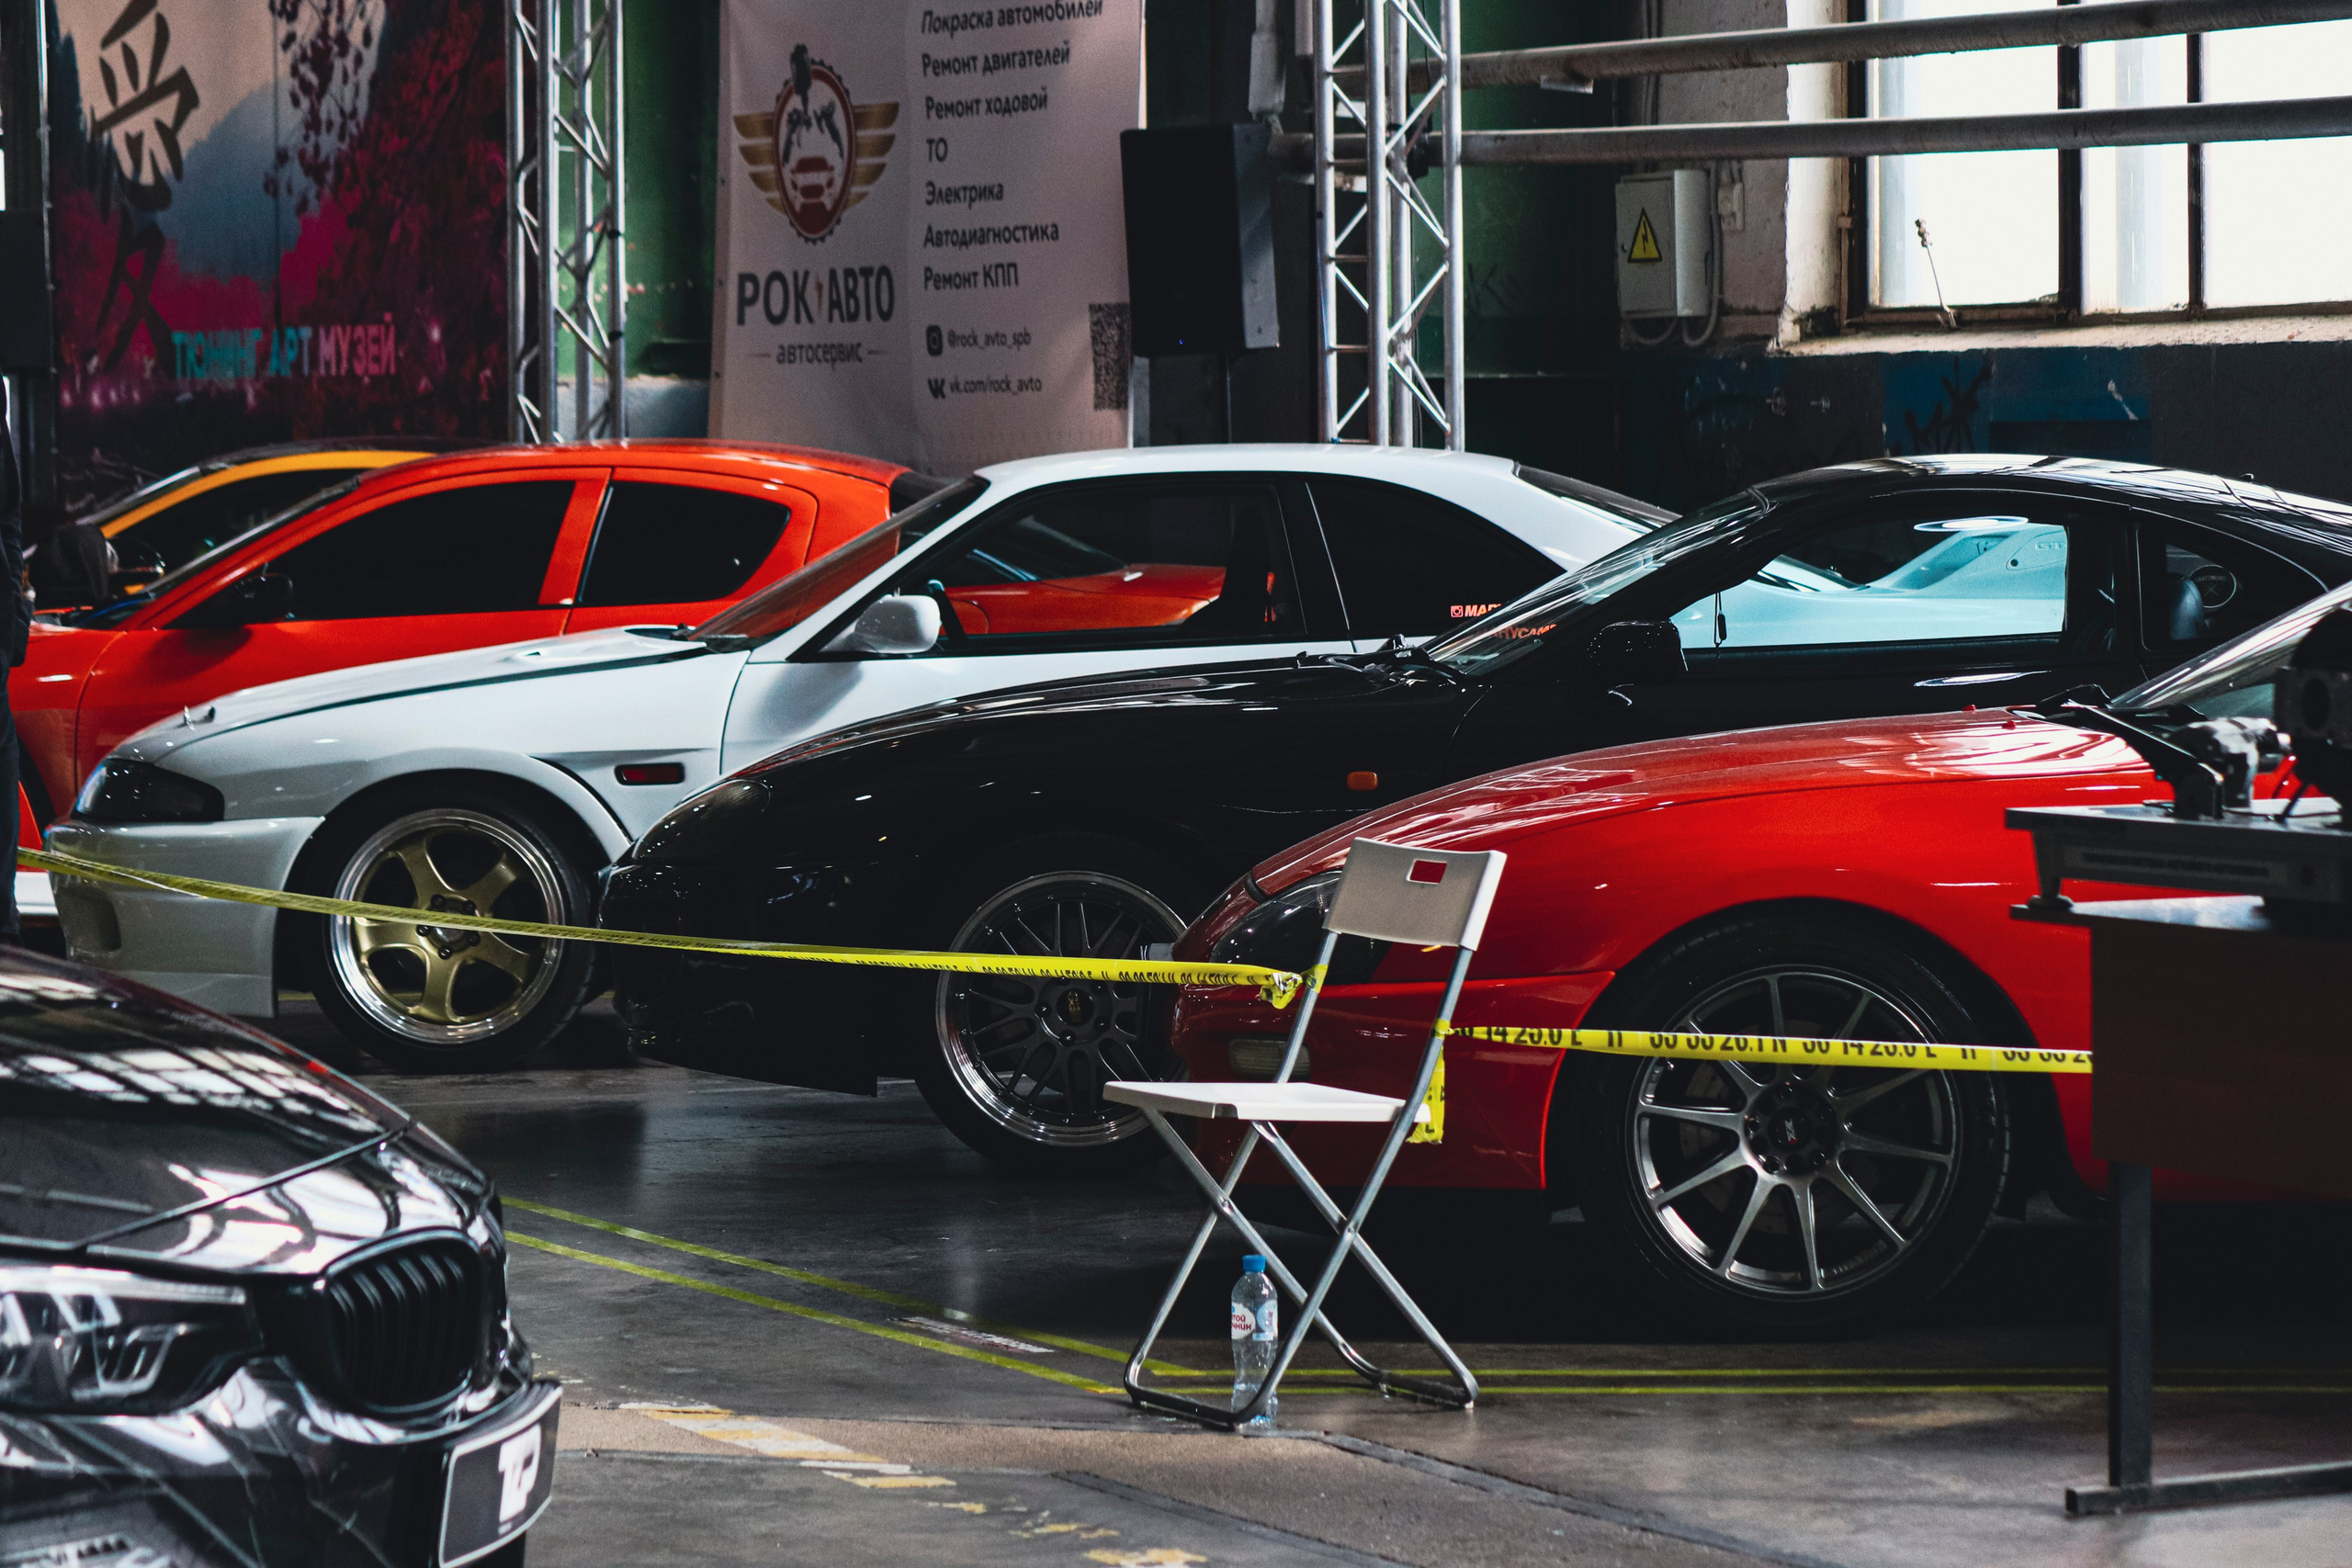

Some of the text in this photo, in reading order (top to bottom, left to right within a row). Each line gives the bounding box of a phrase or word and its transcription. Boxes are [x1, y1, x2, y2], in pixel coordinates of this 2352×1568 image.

[921, 0, 1103, 39] Покраска автомобилей
[922, 39, 1070, 77] Ремонт двигателей
[925, 86, 1048, 119] Ремонт ходовой
[925, 137, 949, 163] ТО
[925, 181, 1004, 210] Электрика
[922, 222, 1060, 251] Автодиагностика
[923, 262, 1020, 291] Ремонт КПП
[737, 265, 895, 326] РОК АВТО
[268, 325, 312, 377] АРТ
[318, 311, 396, 378] МУЗЕЙ
[947, 327, 1032, 352] @rock_avto_spb
[776, 342, 864, 370] автосервис
[949, 373, 1044, 396] vk.com/rock_avto
[2034, 541, 2066, 551] GT
